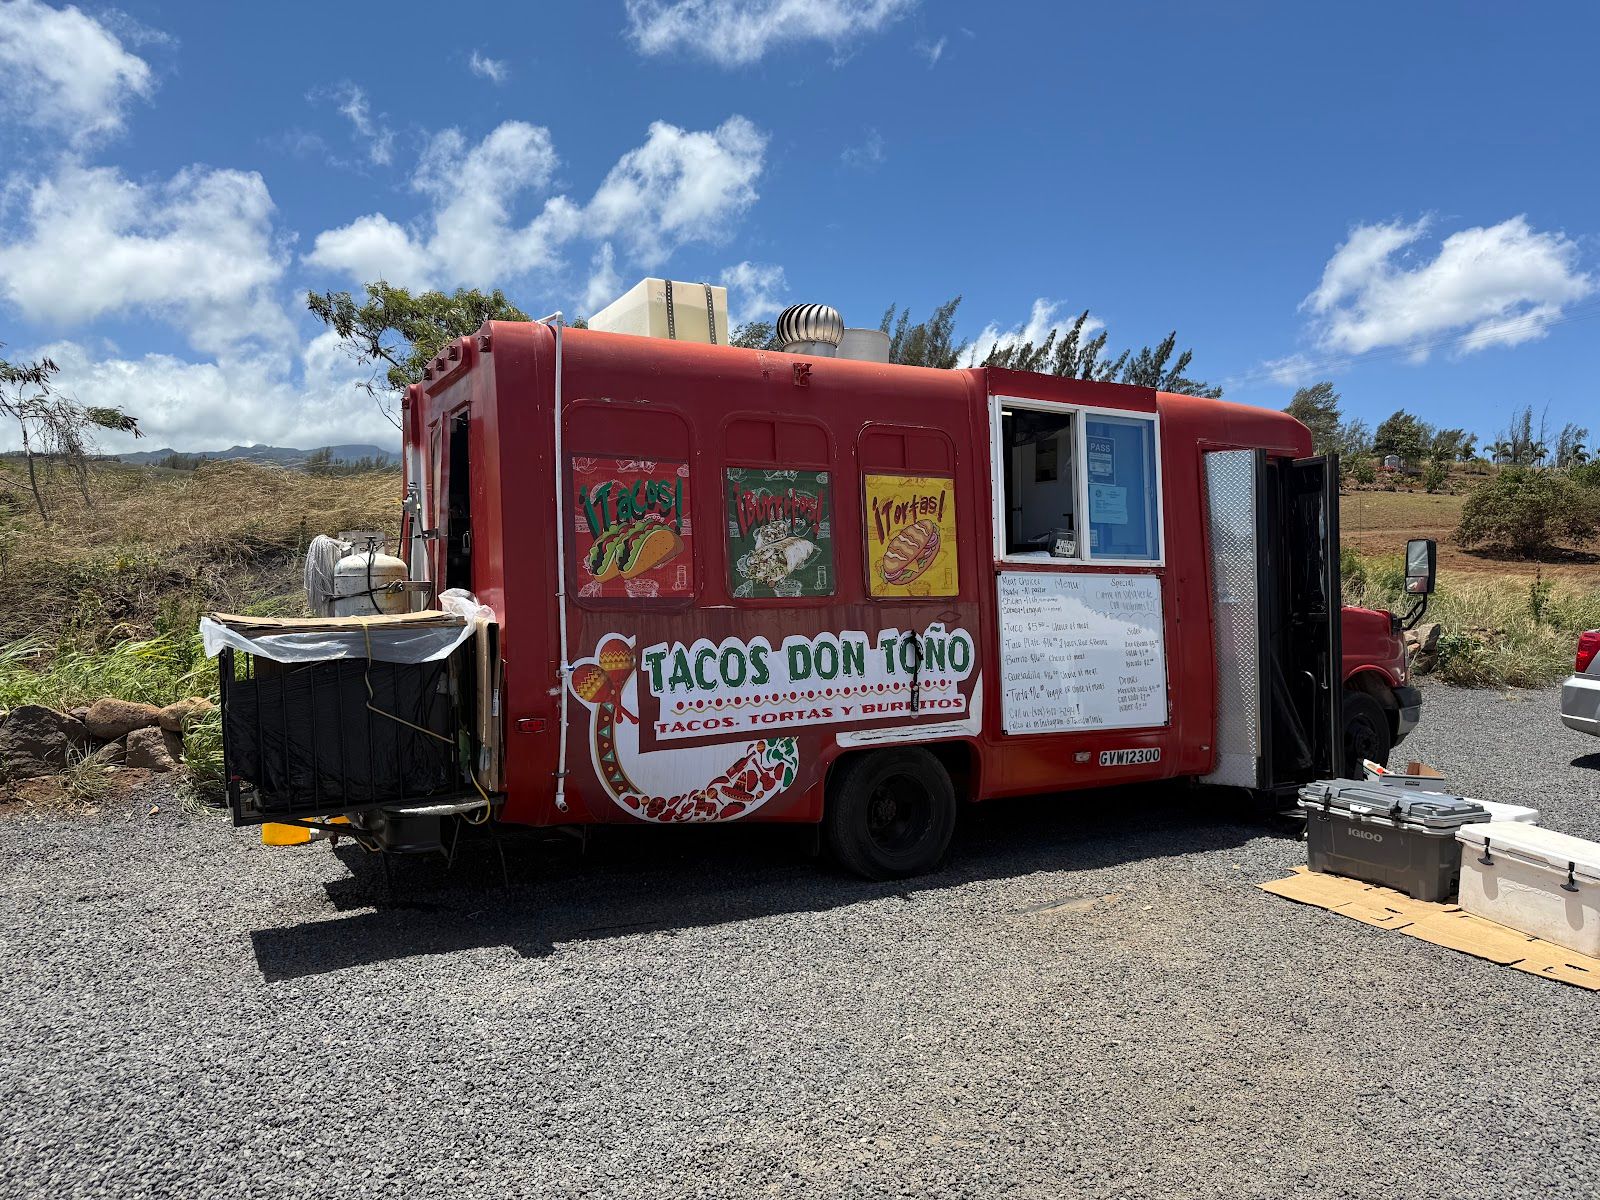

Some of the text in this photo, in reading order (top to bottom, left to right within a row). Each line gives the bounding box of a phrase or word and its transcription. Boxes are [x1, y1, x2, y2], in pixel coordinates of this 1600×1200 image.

[1090, 442, 1111, 453] PASS
[871, 490, 944, 550] ¡Tortas!
[1054, 578, 1080, 590] Menu
[1006, 622, 1023, 634] Taco
[645, 626, 971, 693] TACOS DON TOÑO
[749, 707, 834, 726] TORTAS
[841, 705, 854, 716] Y
[1100, 748, 1160, 765] GVW12300
[1347, 827, 1383, 842] IGLOO
